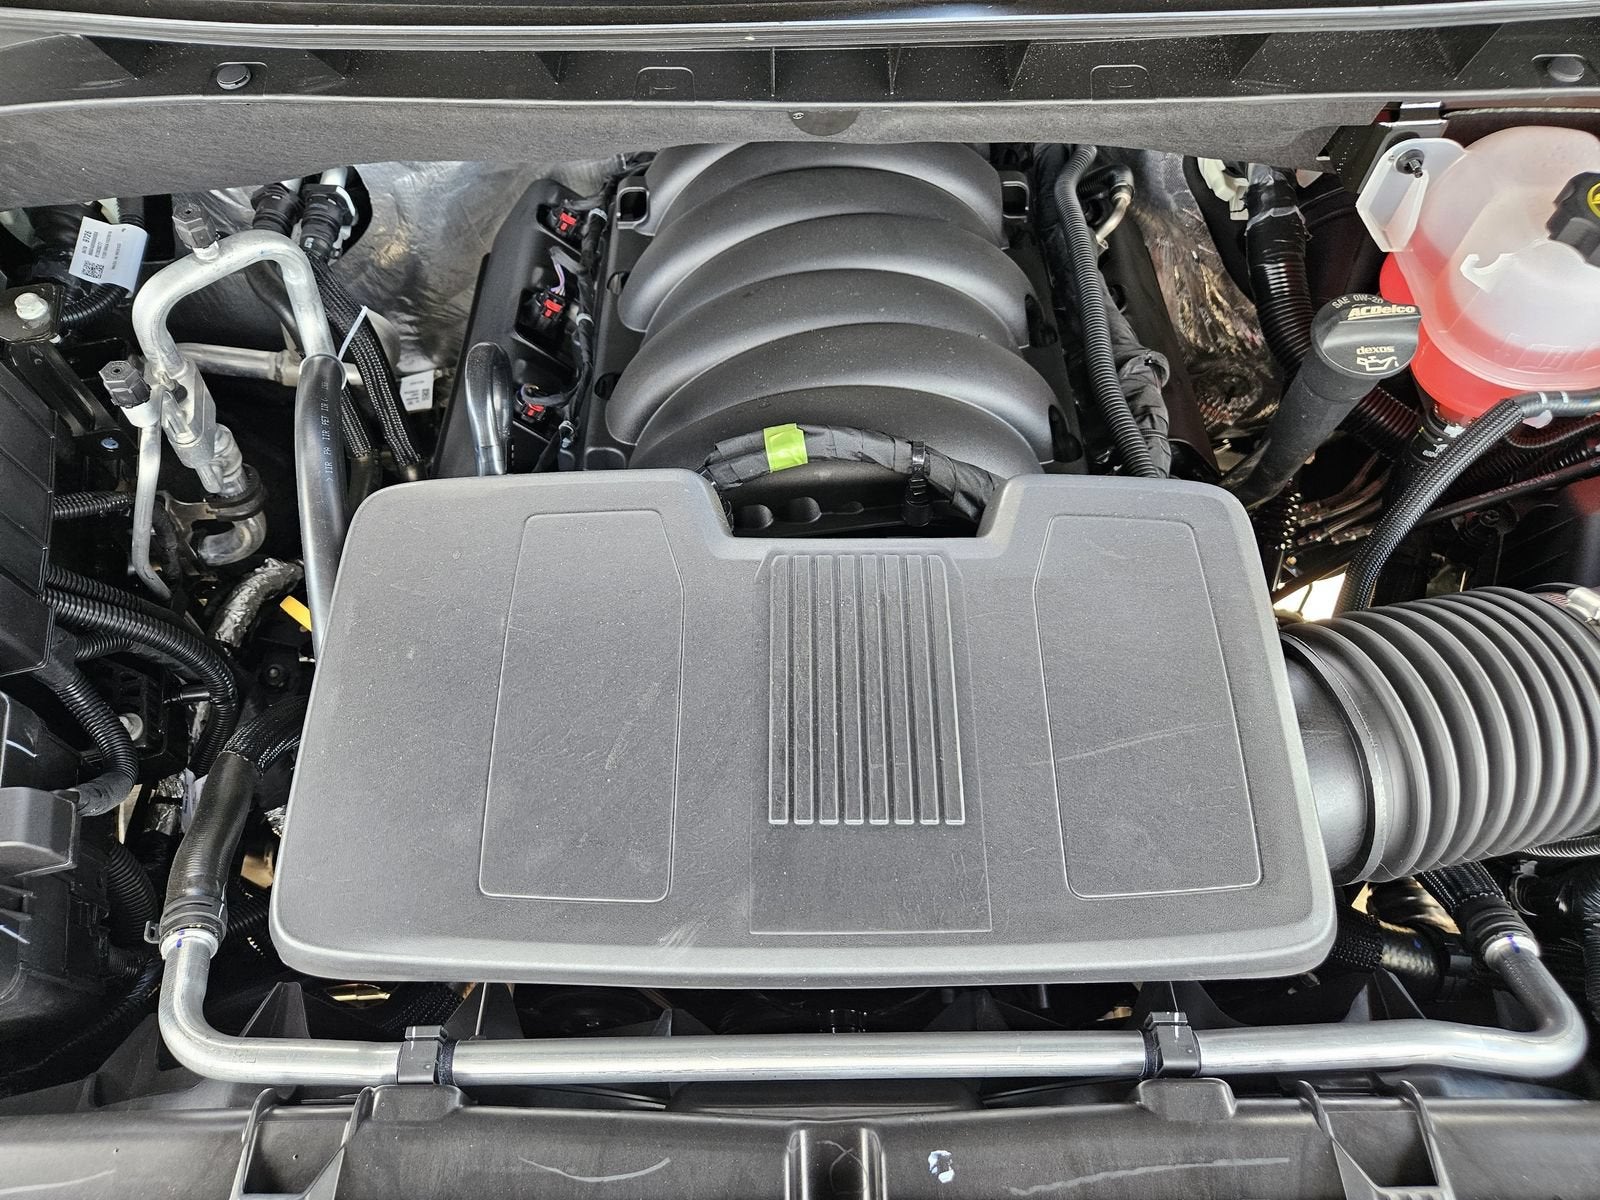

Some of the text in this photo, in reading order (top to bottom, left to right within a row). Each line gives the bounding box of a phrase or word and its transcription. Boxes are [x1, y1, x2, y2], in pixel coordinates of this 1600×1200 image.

[1332, 296, 1350, 308] SAE
[1348, 304, 1416, 317] ACDelco
[1356, 346, 1395, 354] dexos
